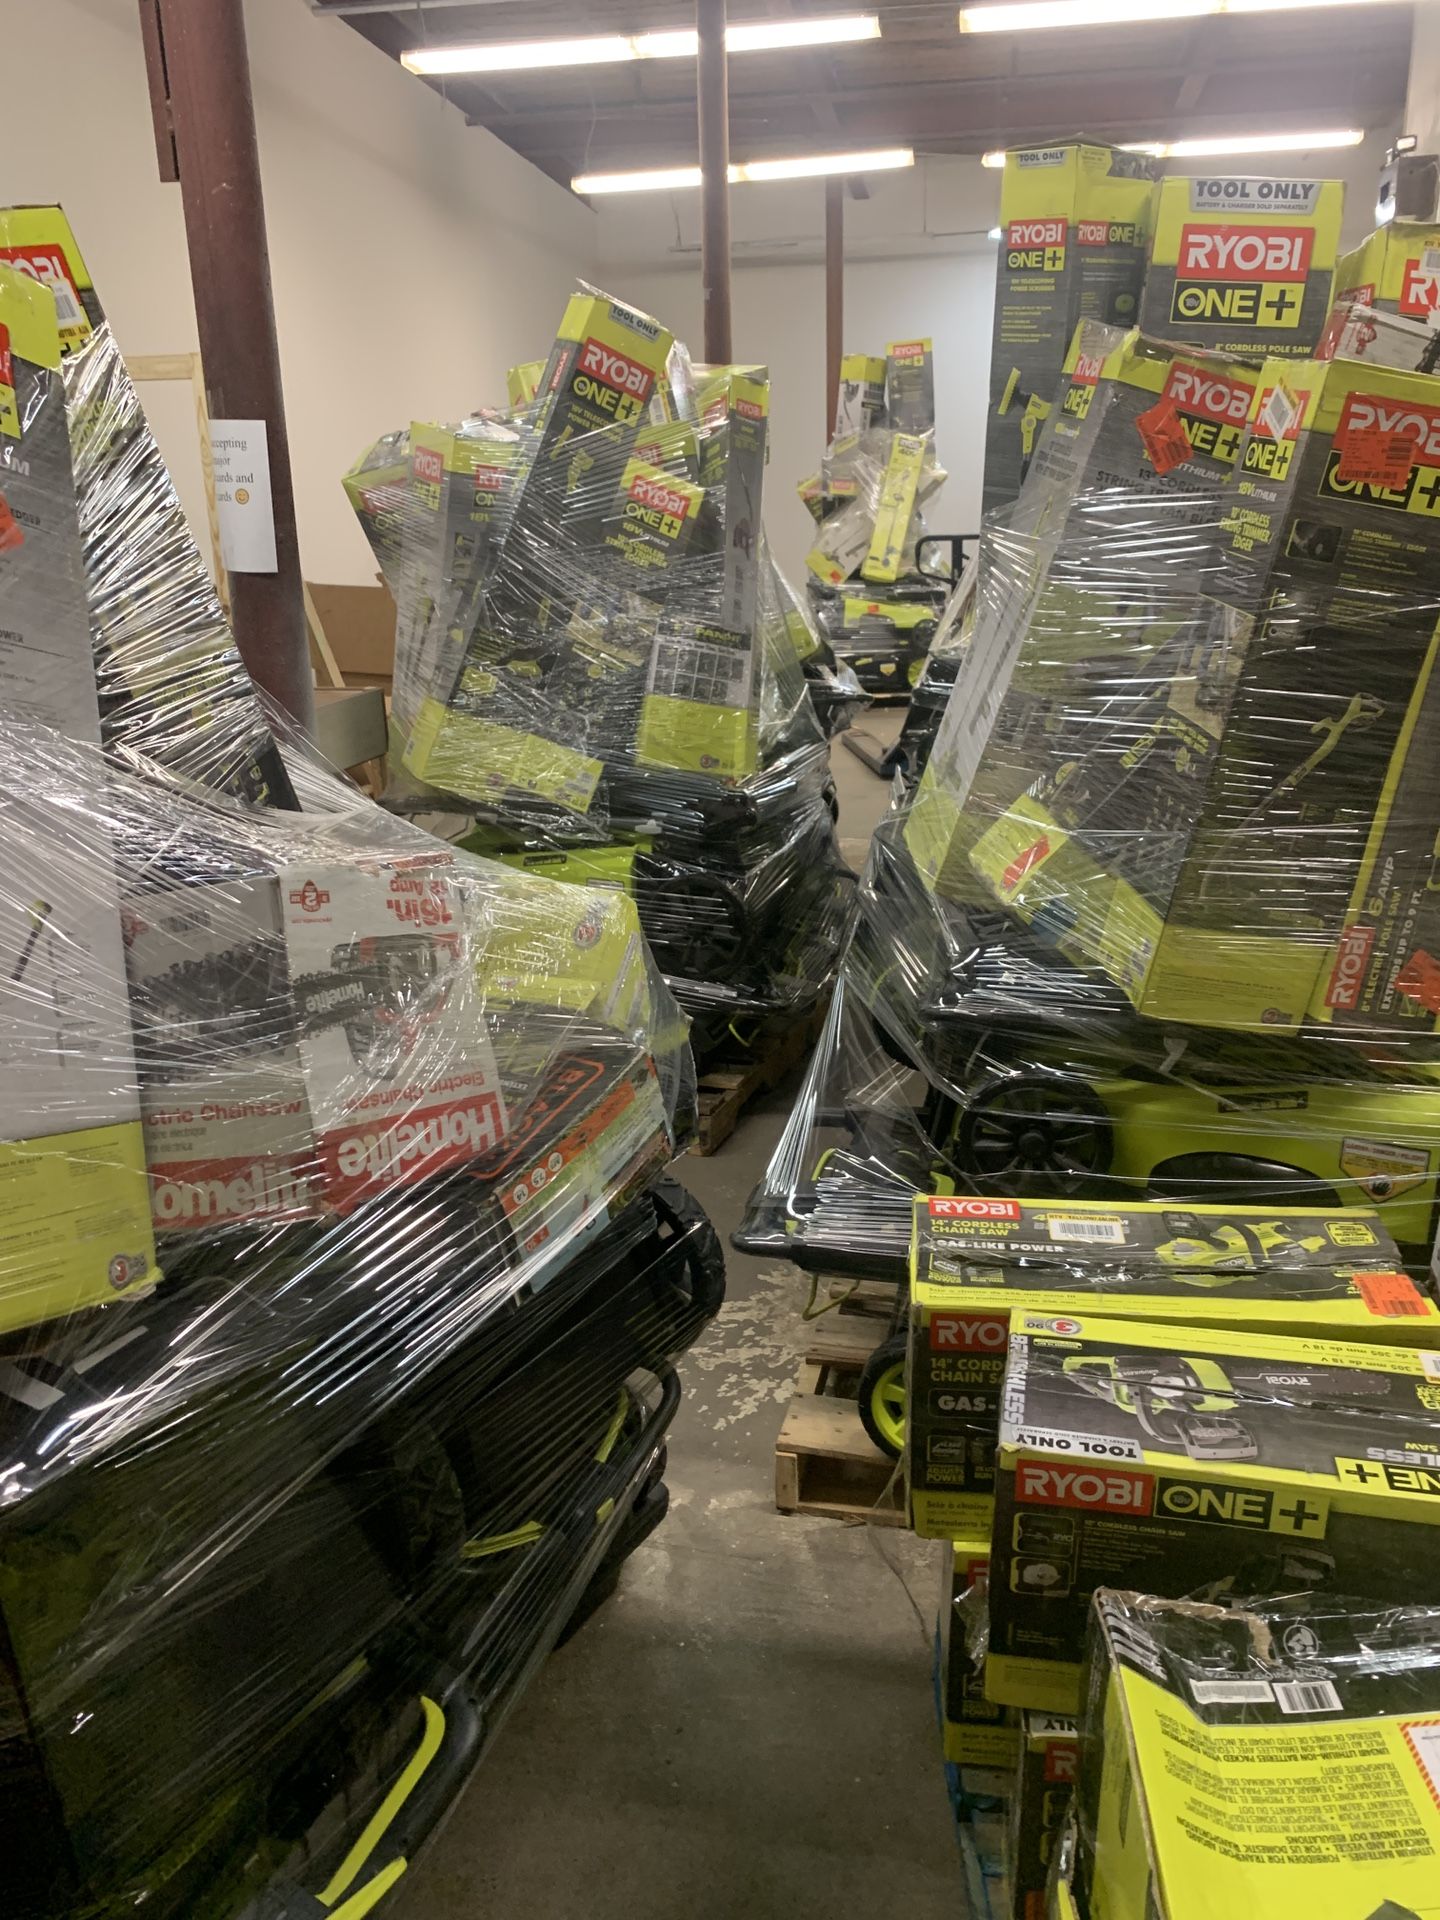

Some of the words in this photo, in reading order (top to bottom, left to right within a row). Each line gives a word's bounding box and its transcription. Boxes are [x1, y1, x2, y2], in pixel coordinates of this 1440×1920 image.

[1020, 152, 1039, 162] TOOL
[1042, 151, 1064, 161] ONLY
[1196, 180, 1250, 198] TOOL
[1257, 182, 1315, 200] ONLY
[1011, 223, 1063, 244] RYOBI
[1078, 224, 1107, 241] RYOBI
[1186, 234, 1304, 271] RYOBI
[1177, 286, 1300, 324] ONE+
[612, 306, 635, 324] TOOL
[636, 319, 659, 337] ONLY
[1225, 344, 1267, 352] CORDLESS
[583, 344, 649, 395] RYOBI
[1169, 371, 1251, 419] RYOB
[1347, 403, 1440, 456] RYOB
[1179, 417, 1240, 460] NE+
[414, 453, 442, 479] RYOBI
[1245, 441, 1294, 480] ONE+
[235, 472, 254, 483] and
[634, 478, 686, 515] RYOBI
[1251, 489, 1278, 502] LITHIUM
[626, 503, 678, 537] ONE+
[1240, 508, 1271, 527] CORDLESS
[1232, 535, 1254, 552] EDGER
[388, 878, 424, 896] Amp
[1368, 897, 1384, 917] 6
[1377, 856, 1395, 898] AMP
[1378, 918, 1395, 948] POLE
[1387, 892, 1402, 916] SAW
[1331, 931, 1370, 1004] RYOBI
[1380, 957, 1402, 1010] EXTENDS
[1395, 937, 1408, 955] UP
[1402, 919, 1414, 935] TO
[305, 980, 367, 1014] Homelite
[430, 1070, 486, 1094] Electric
[337, 1104, 497, 1182] Homelite
[931, 1199, 1015, 1217] RYOBI
[931, 1226, 975, 1235] CHAIN
[979, 1228, 1009, 1237] SAW
[951, 1219, 1020, 1231] CORDLESS
[936, 1238, 1007, 1251] GAS-LIKE
[1010, 1243, 1065, 1254] POWER
[936, 1319, 1008, 1347] RYO
[1370, 1350, 1391, 1358] 305
[957, 1358, 1004, 1371] CORD
[1391, 1363, 1412, 1372] 305
[930, 1369, 984, 1384] CHAIN
[1003, 1332, 1029, 1426] BRUSHLESS
[1266, 1374, 1312, 1386] RYOBI
[937, 1394, 998, 1412] GAS-
[1015, 1433, 1072, 1449] ONLY
[1404, 1442, 1439, 1454] SAW
[1079, 1441, 1137, 1459] TOOL
[1346, 1463, 1440, 1490] NE+
[1023, 1468, 1144, 1508] RYOBI
[1163, 1485, 1323, 1534] ONE+
[1223, 1755, 1255, 1763] PACKED
[1257, 1754, 1299, 1763] BATTERIES
[1300, 1750, 1358, 1762] LITHIUM-ION
[1176, 1816, 1241, 1853] TRANSPORTATION
[1291, 1823, 1340, 1833] TRANSPORT
[1369, 1831, 1401, 1841] UNDER
[1403, 1827, 1426, 1840] ONLY
[1286, 1834, 1346, 1845] REGULATIONS
[1349, 1832, 1367, 1842] DOT
[1366, 1841, 1386, 1850] AND
[1388, 1838, 1430, 1849] AIRCRAFT
[1219, 1847, 1266, 1864] TRANSPORT
[1243, 1844, 1288, 1854] DOMESTIC
[1290, 1846, 1300, 1854] US
[1304, 1845, 1321, 1854] FOR
[1334, 1843, 1364, 1853] VESSEL
[1348, 1850, 1395, 1862] BATTERIES
[1396, 1847, 1436, 1858] LITHIUM
[1268, 1855, 1285, 1864] FOR
[1287, 1854, 1340, 1865] FORBIDDEN
